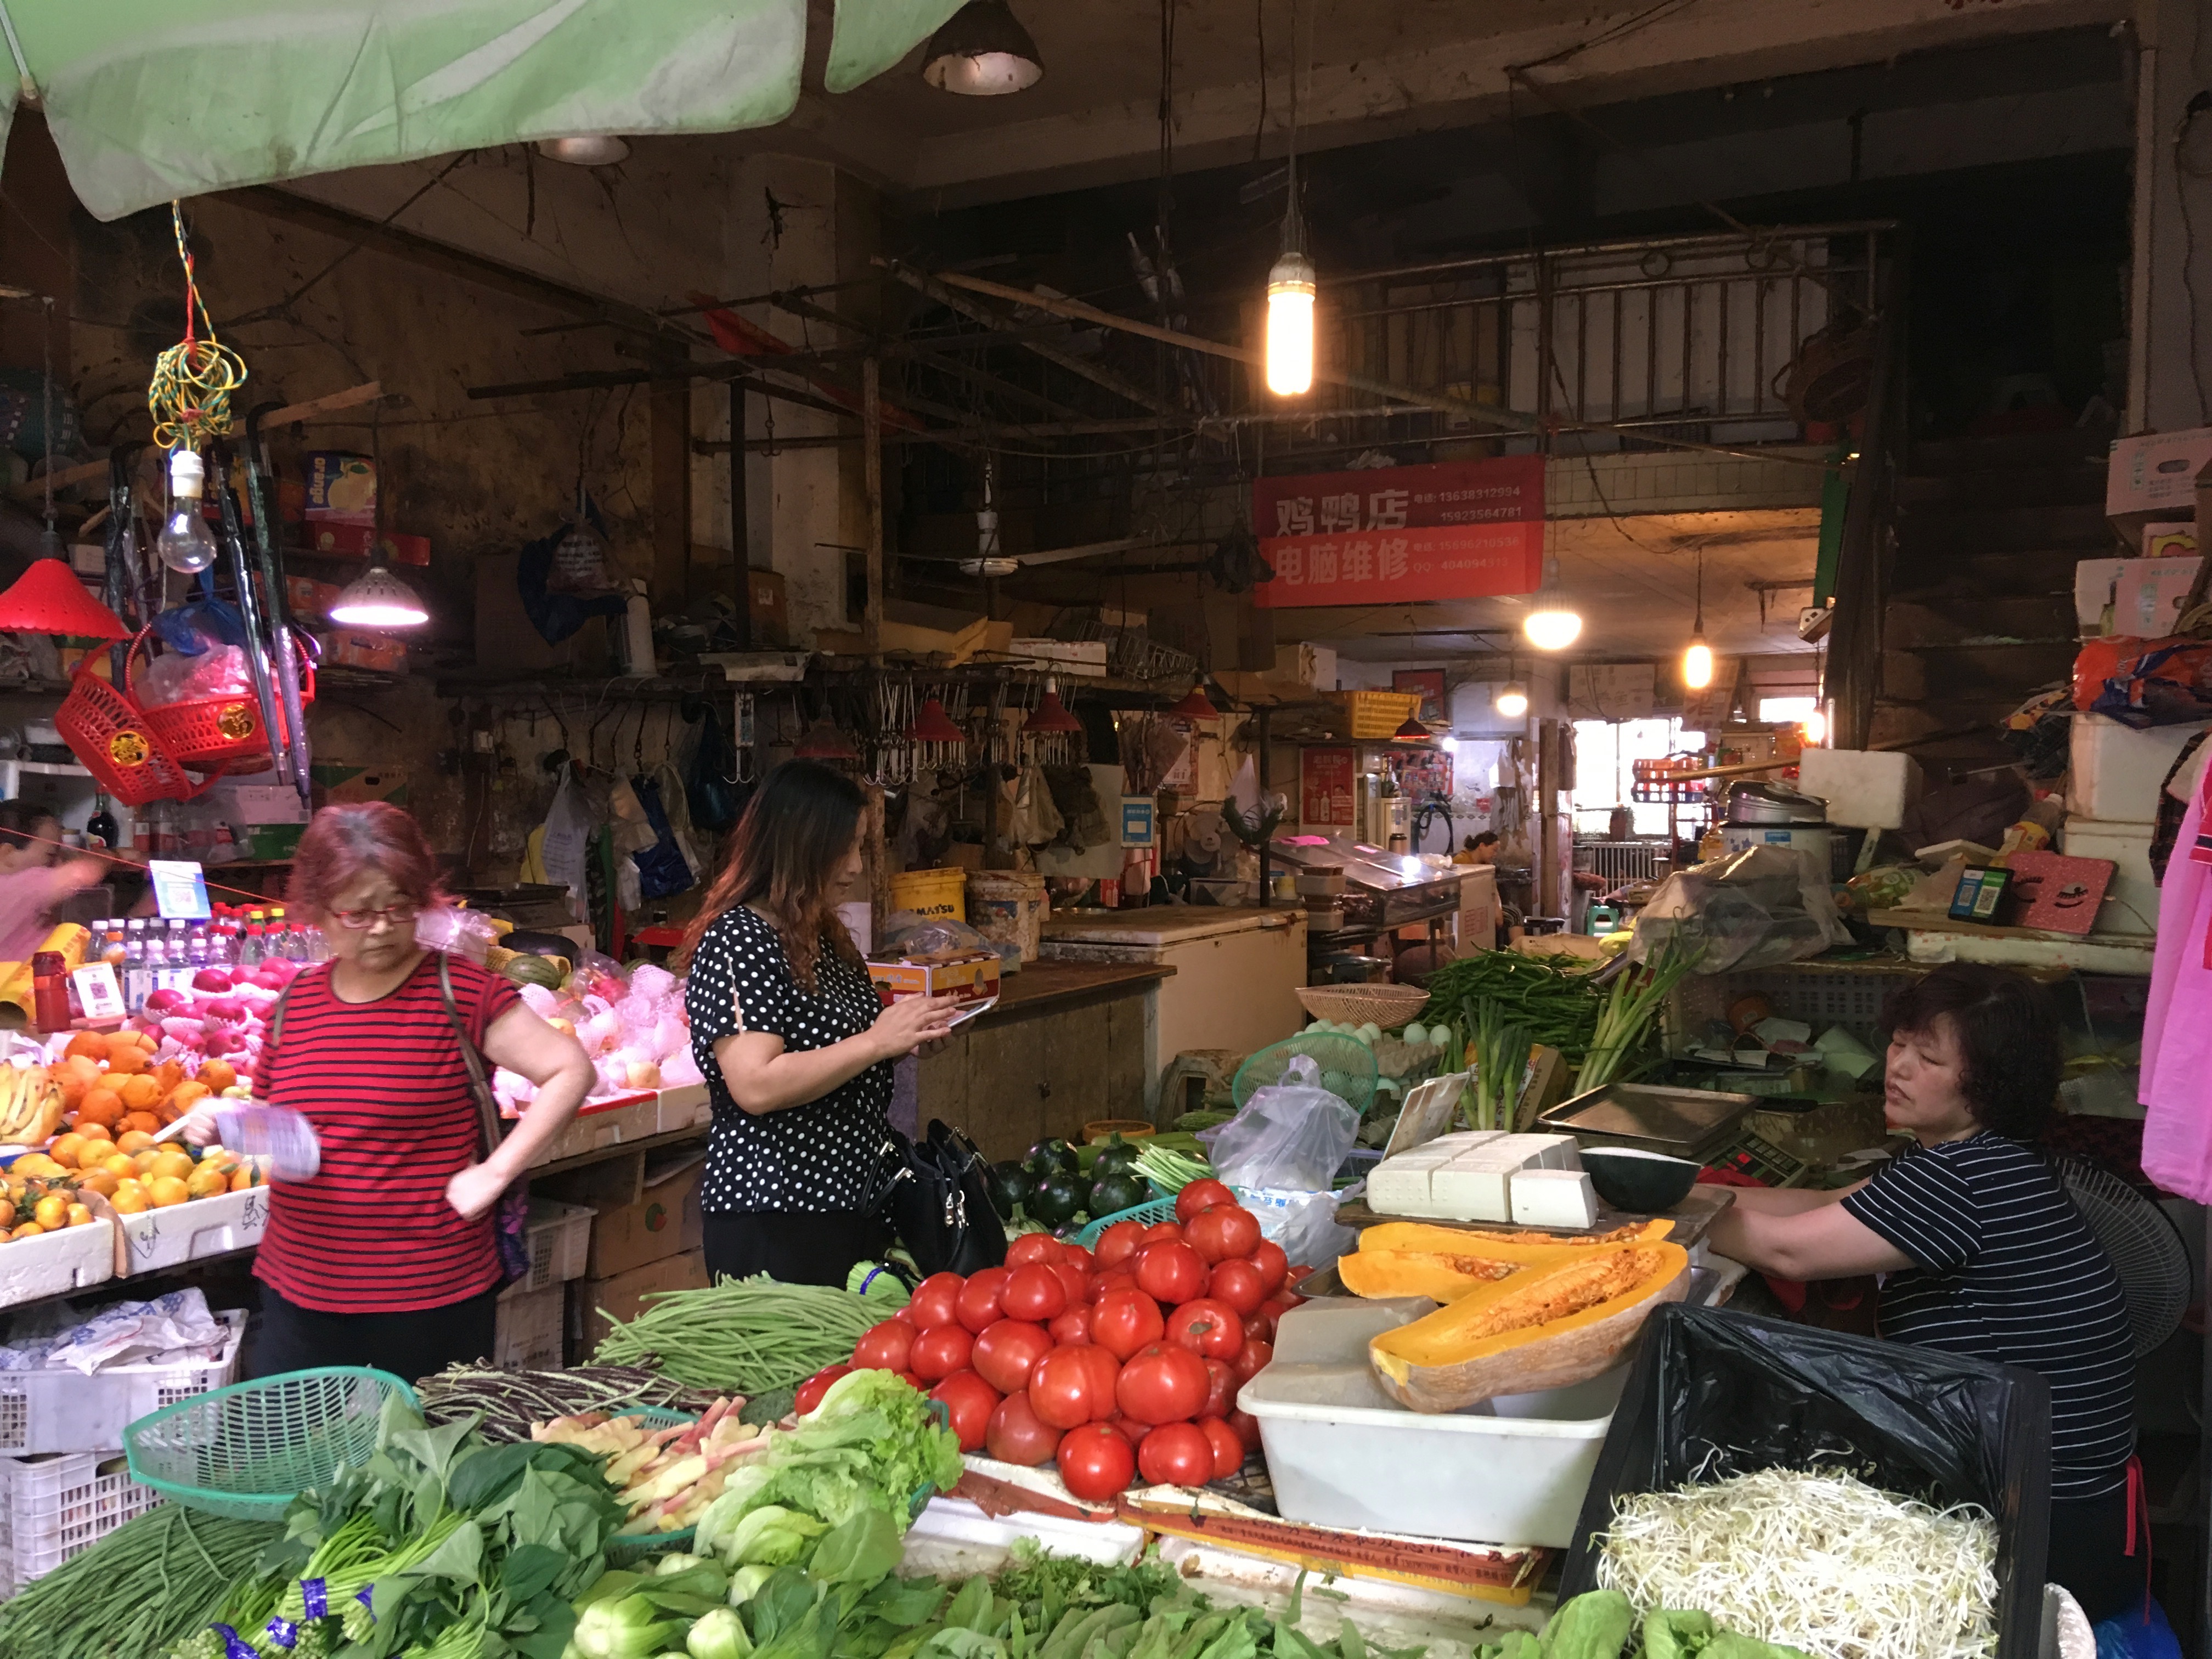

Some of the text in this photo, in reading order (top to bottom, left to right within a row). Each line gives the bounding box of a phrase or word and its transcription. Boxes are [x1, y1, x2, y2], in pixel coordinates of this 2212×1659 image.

[1440, 486, 1520, 502] 13638312994
[1277, 489, 1408, 537] 鸡鸭店
[1441, 507, 1521, 521] 15923564781
[1440, 537, 1519, 550] 15696210536
[1276, 538, 1408, 585] 电脑维修
[1441, 557, 1509, 570] 404094313
[911, 904, 955, 916] MATSU
